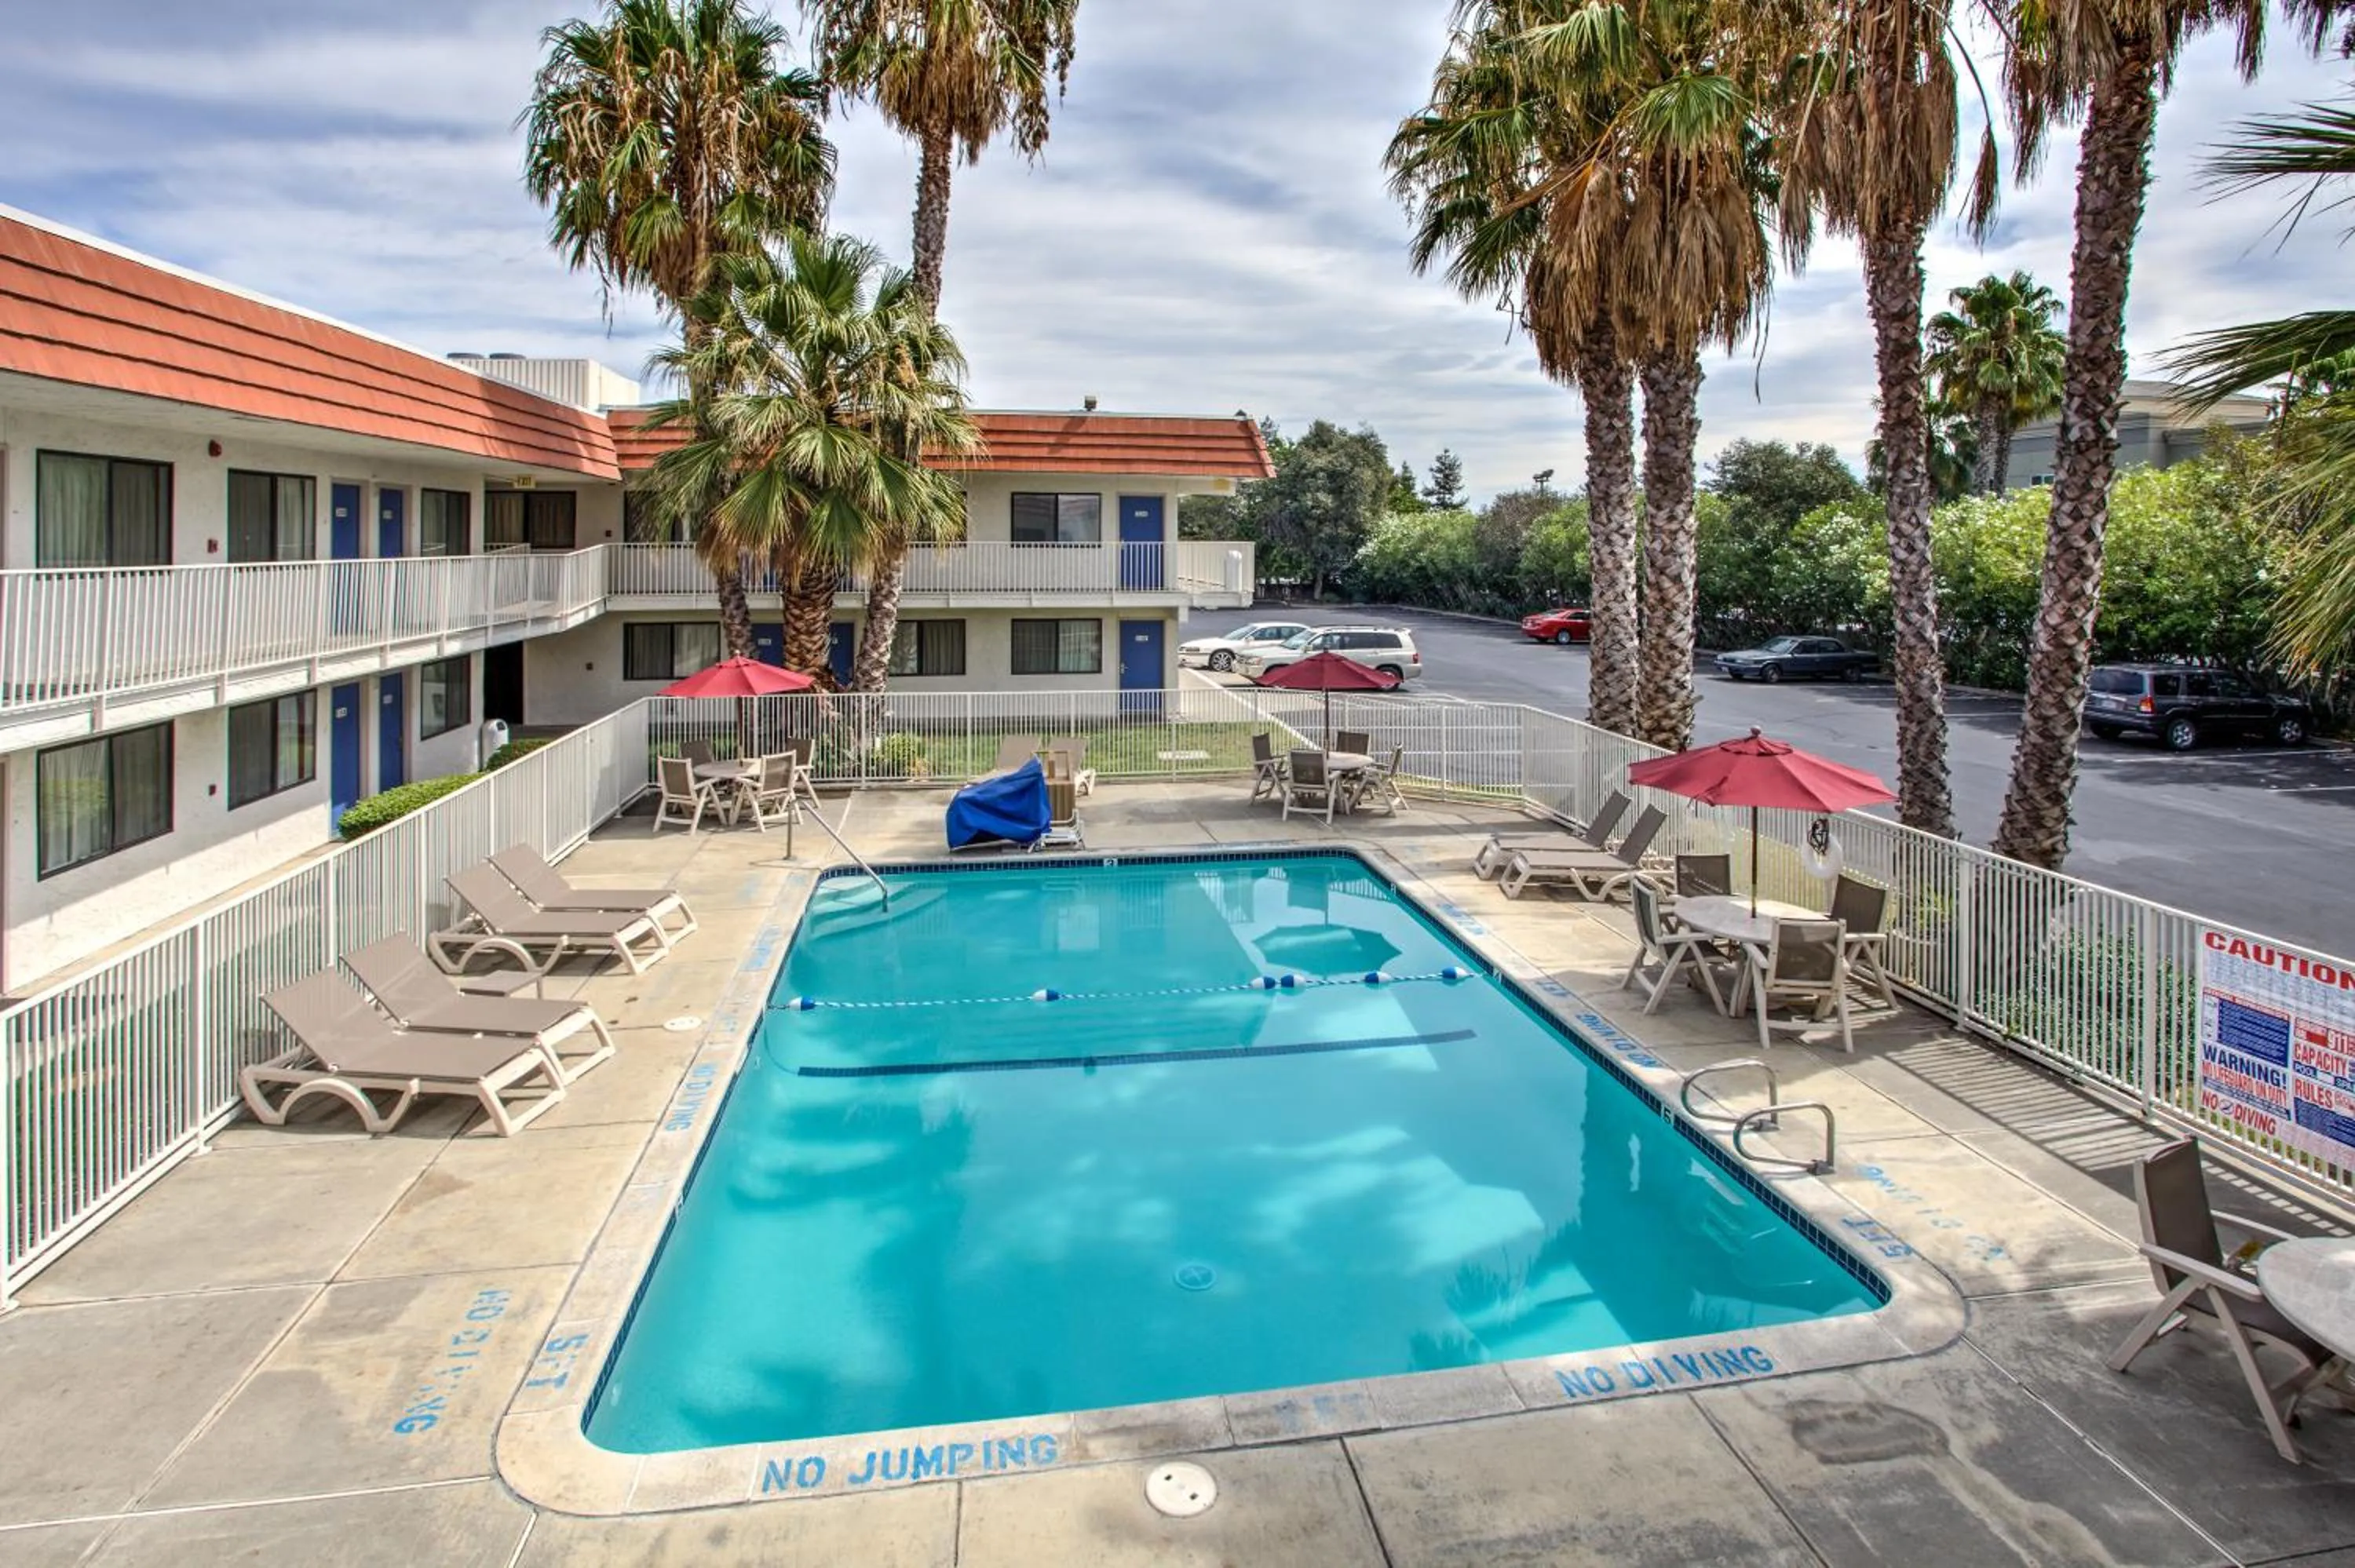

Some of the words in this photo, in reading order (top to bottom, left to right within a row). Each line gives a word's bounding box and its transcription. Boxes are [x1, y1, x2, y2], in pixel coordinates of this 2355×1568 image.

[2205, 932, 2355, 990] CAUTION
[2203, 1043, 2287, 1089] WARNING!
[2294, 1042, 2347, 1077] CAPACITY
[2294, 1063, 2314, 1079] POOL
[2202, 1091, 2218, 1110] NO
[2233, 1103, 2276, 1135] DIVING
[2295, 1078, 2332, 1109] RULES
[1555, 1366, 1616, 1398] NO
[1622, 1345, 1774, 1388] DIVING
[761, 1456, 827, 1494] NO
[848, 1433, 1058, 1485] JUMPING
